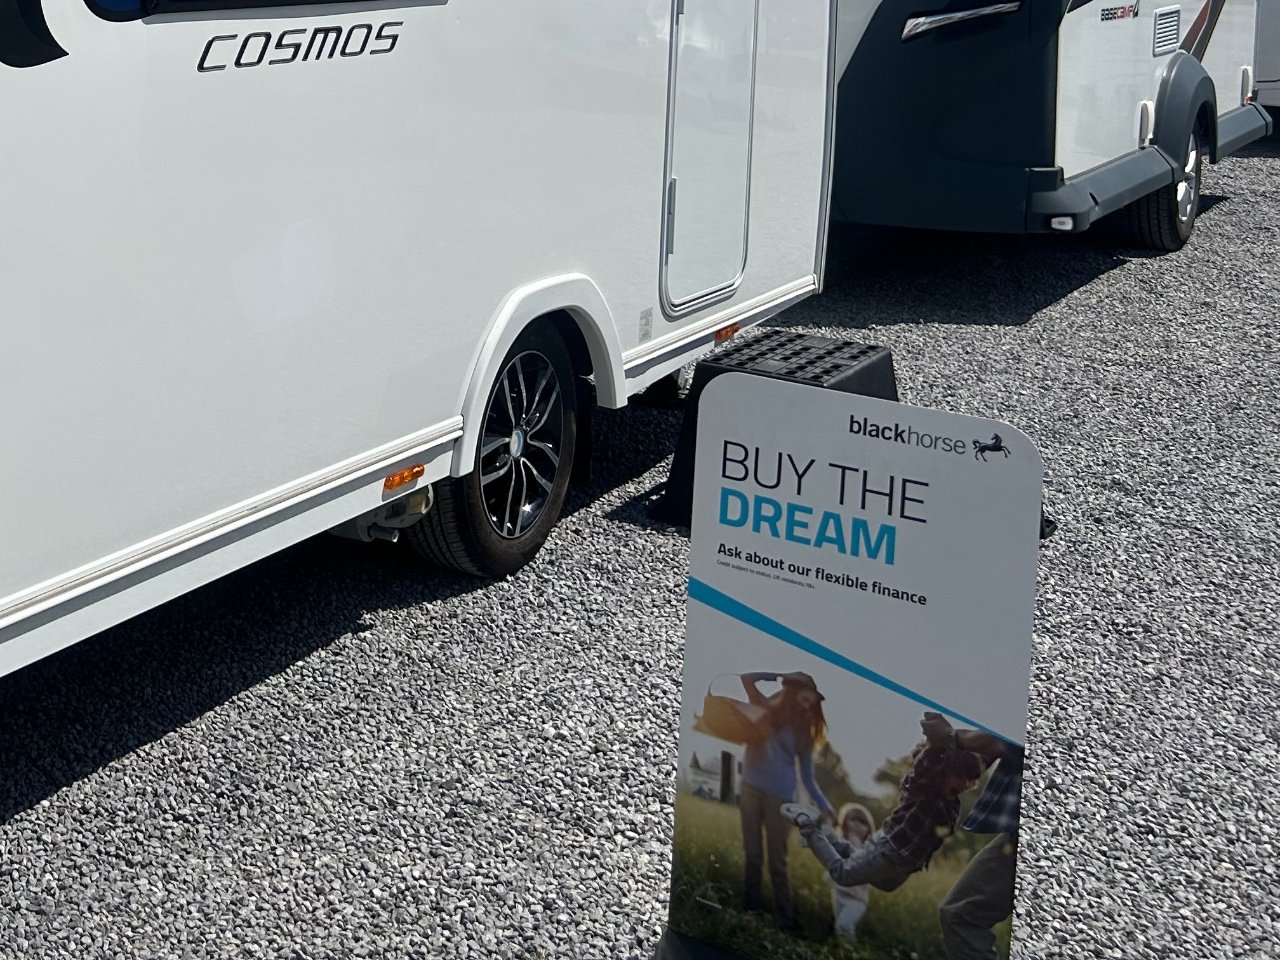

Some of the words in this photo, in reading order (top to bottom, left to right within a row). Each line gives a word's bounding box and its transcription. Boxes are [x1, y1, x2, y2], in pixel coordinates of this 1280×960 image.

[197, 21, 404, 72] COSMOS
[848, 414, 967, 455] blackhorse
[721, 440, 816, 495] BUY
[828, 462, 930, 524] THE
[719, 486, 897, 566] DREAM
[717, 543, 742, 560] Ask
[745, 552, 785, 571] about
[787, 563, 812, 577] our
[815, 566, 868, 591] flexible
[871, 581, 928, 606] finance
